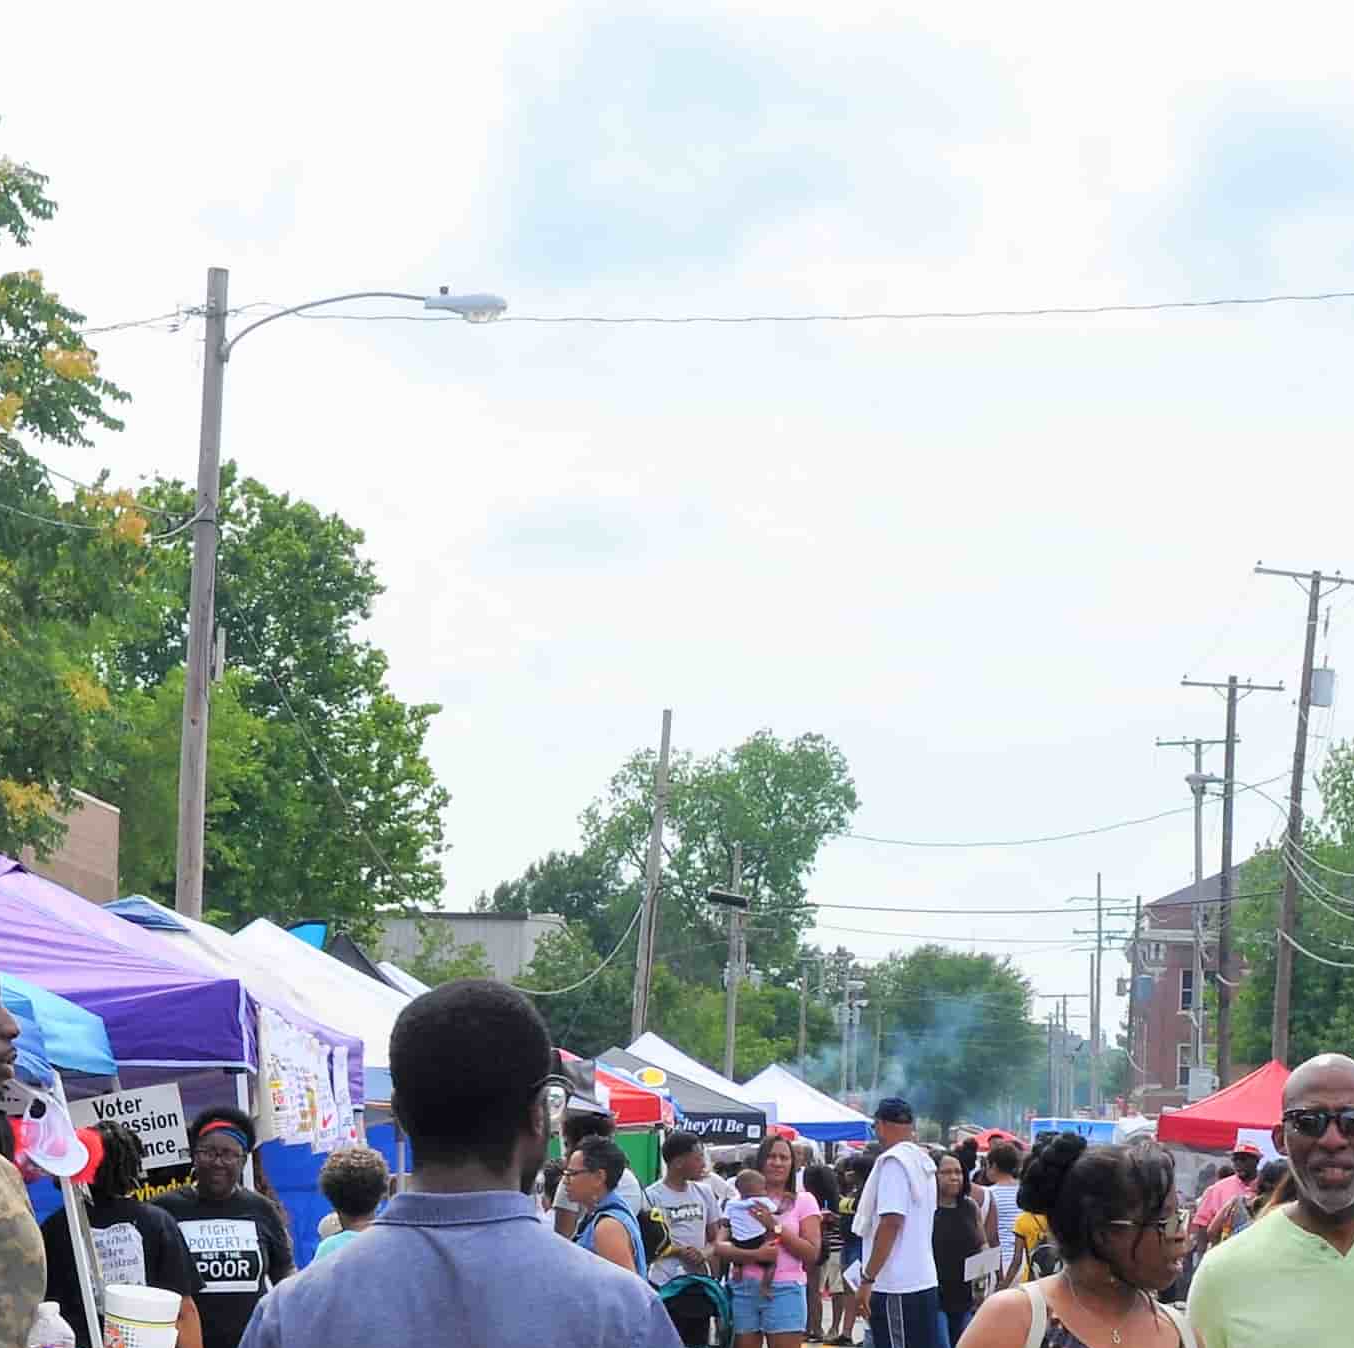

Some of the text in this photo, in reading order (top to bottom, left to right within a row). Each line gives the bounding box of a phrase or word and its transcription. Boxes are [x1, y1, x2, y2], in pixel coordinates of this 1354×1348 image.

[92, 1097, 143, 1120] Voter
[725, 1118, 745, 1133] Be
[199, 1224, 238, 1235] FIGHT
[196, 1260, 250, 1278] POOR
